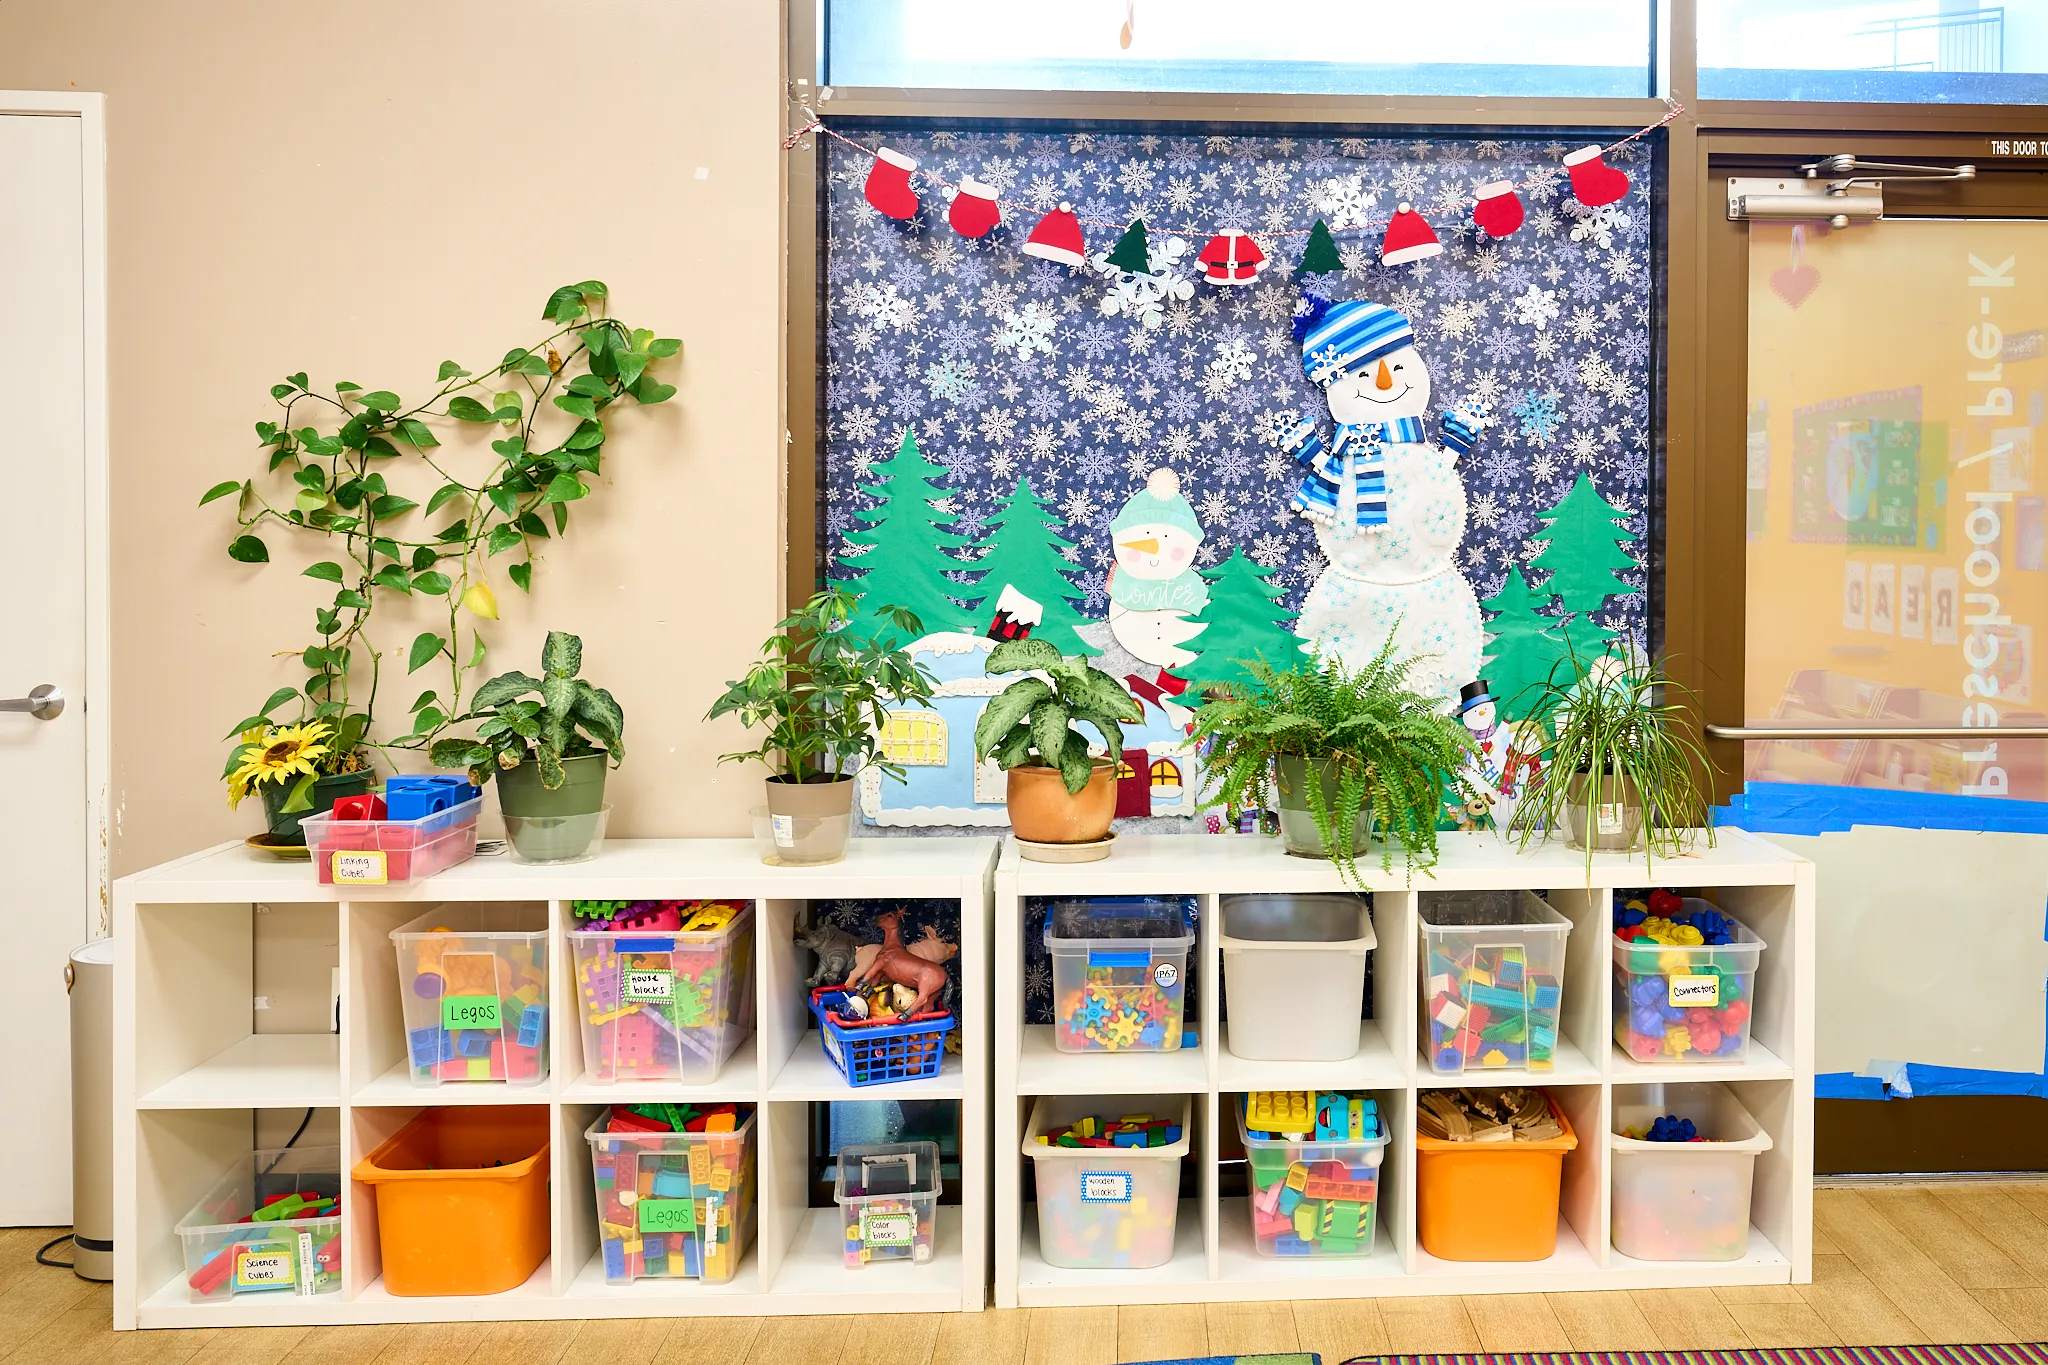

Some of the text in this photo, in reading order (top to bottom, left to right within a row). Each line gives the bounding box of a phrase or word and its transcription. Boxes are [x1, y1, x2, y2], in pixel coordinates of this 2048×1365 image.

[1991, 140, 2010, 155] THIS
[2013, 141, 2037, 156] DOOR
[1120, 581, 1198, 607] winter
[633, 985, 665, 994] blocks
[1673, 984, 1717, 997] Connectors
[451, 1005, 495, 1023] Legos
[1091, 1188, 1117, 1197] blocks
[647, 1206, 689, 1228] Legos
[872, 1231, 897, 1239] blocks
[246, 1258, 279, 1268] Science
